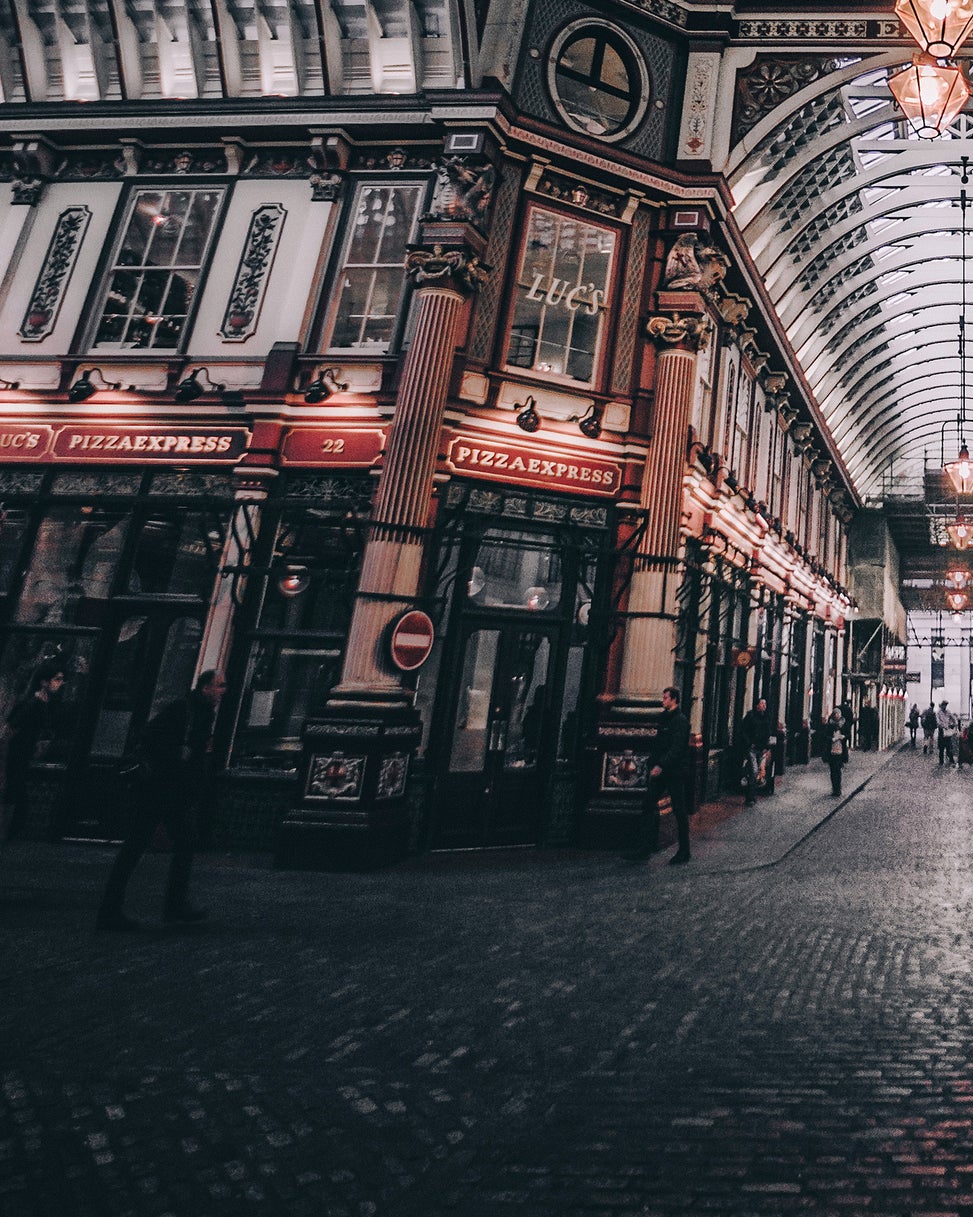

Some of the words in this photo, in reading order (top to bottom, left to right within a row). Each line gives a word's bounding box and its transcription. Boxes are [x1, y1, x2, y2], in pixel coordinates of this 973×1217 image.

[525, 273, 604, 316] LUC'S
[0, 431, 41, 449] UC'S
[69, 434, 233, 453] PIZZAEXPRESS
[322, 439, 345, 453] 22
[456, 446, 615, 486] PIZZAEXPRESS
